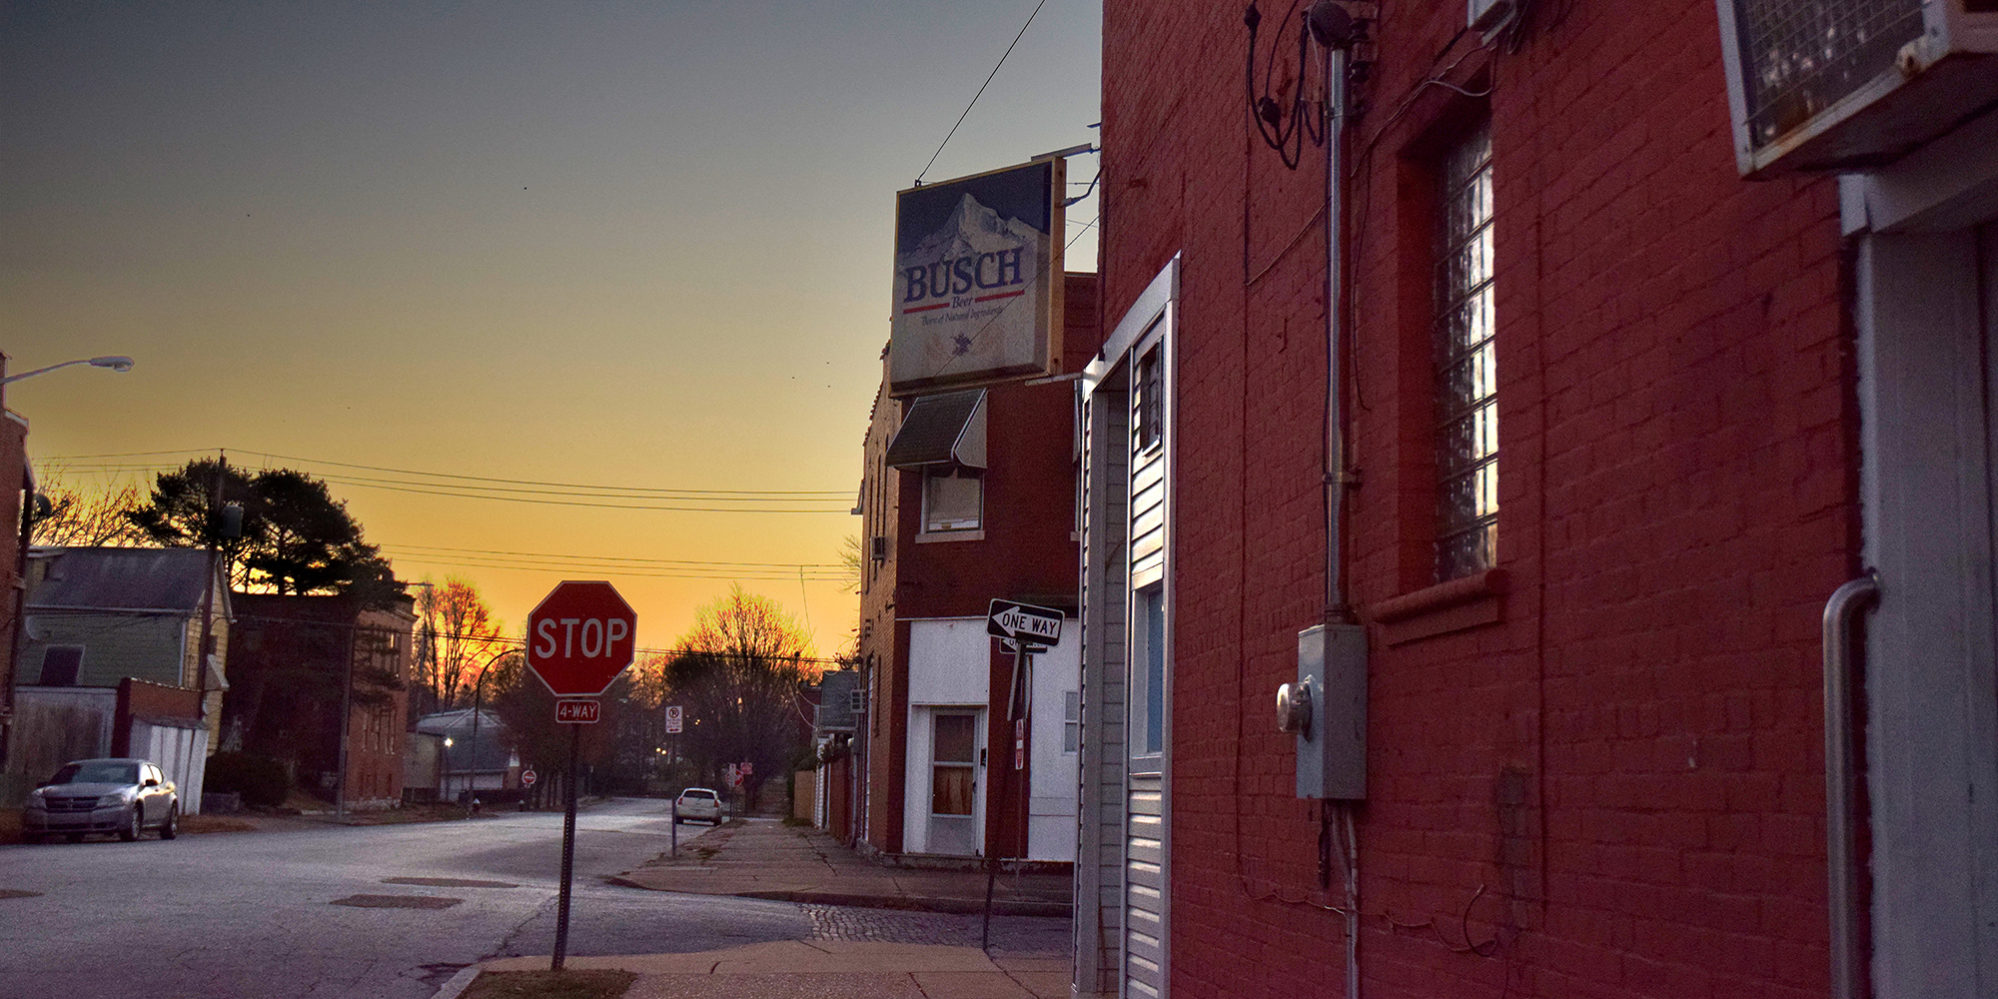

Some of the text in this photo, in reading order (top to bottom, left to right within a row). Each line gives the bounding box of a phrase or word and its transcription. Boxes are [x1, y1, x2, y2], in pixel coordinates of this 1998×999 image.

[904, 247, 1024, 303] BUSCH
[952, 296, 973, 308] Beer
[1002, 613, 1057, 635] ONE WAY
[535, 617, 628, 659] STOP
[560, 705, 597, 718] 4-WAY
